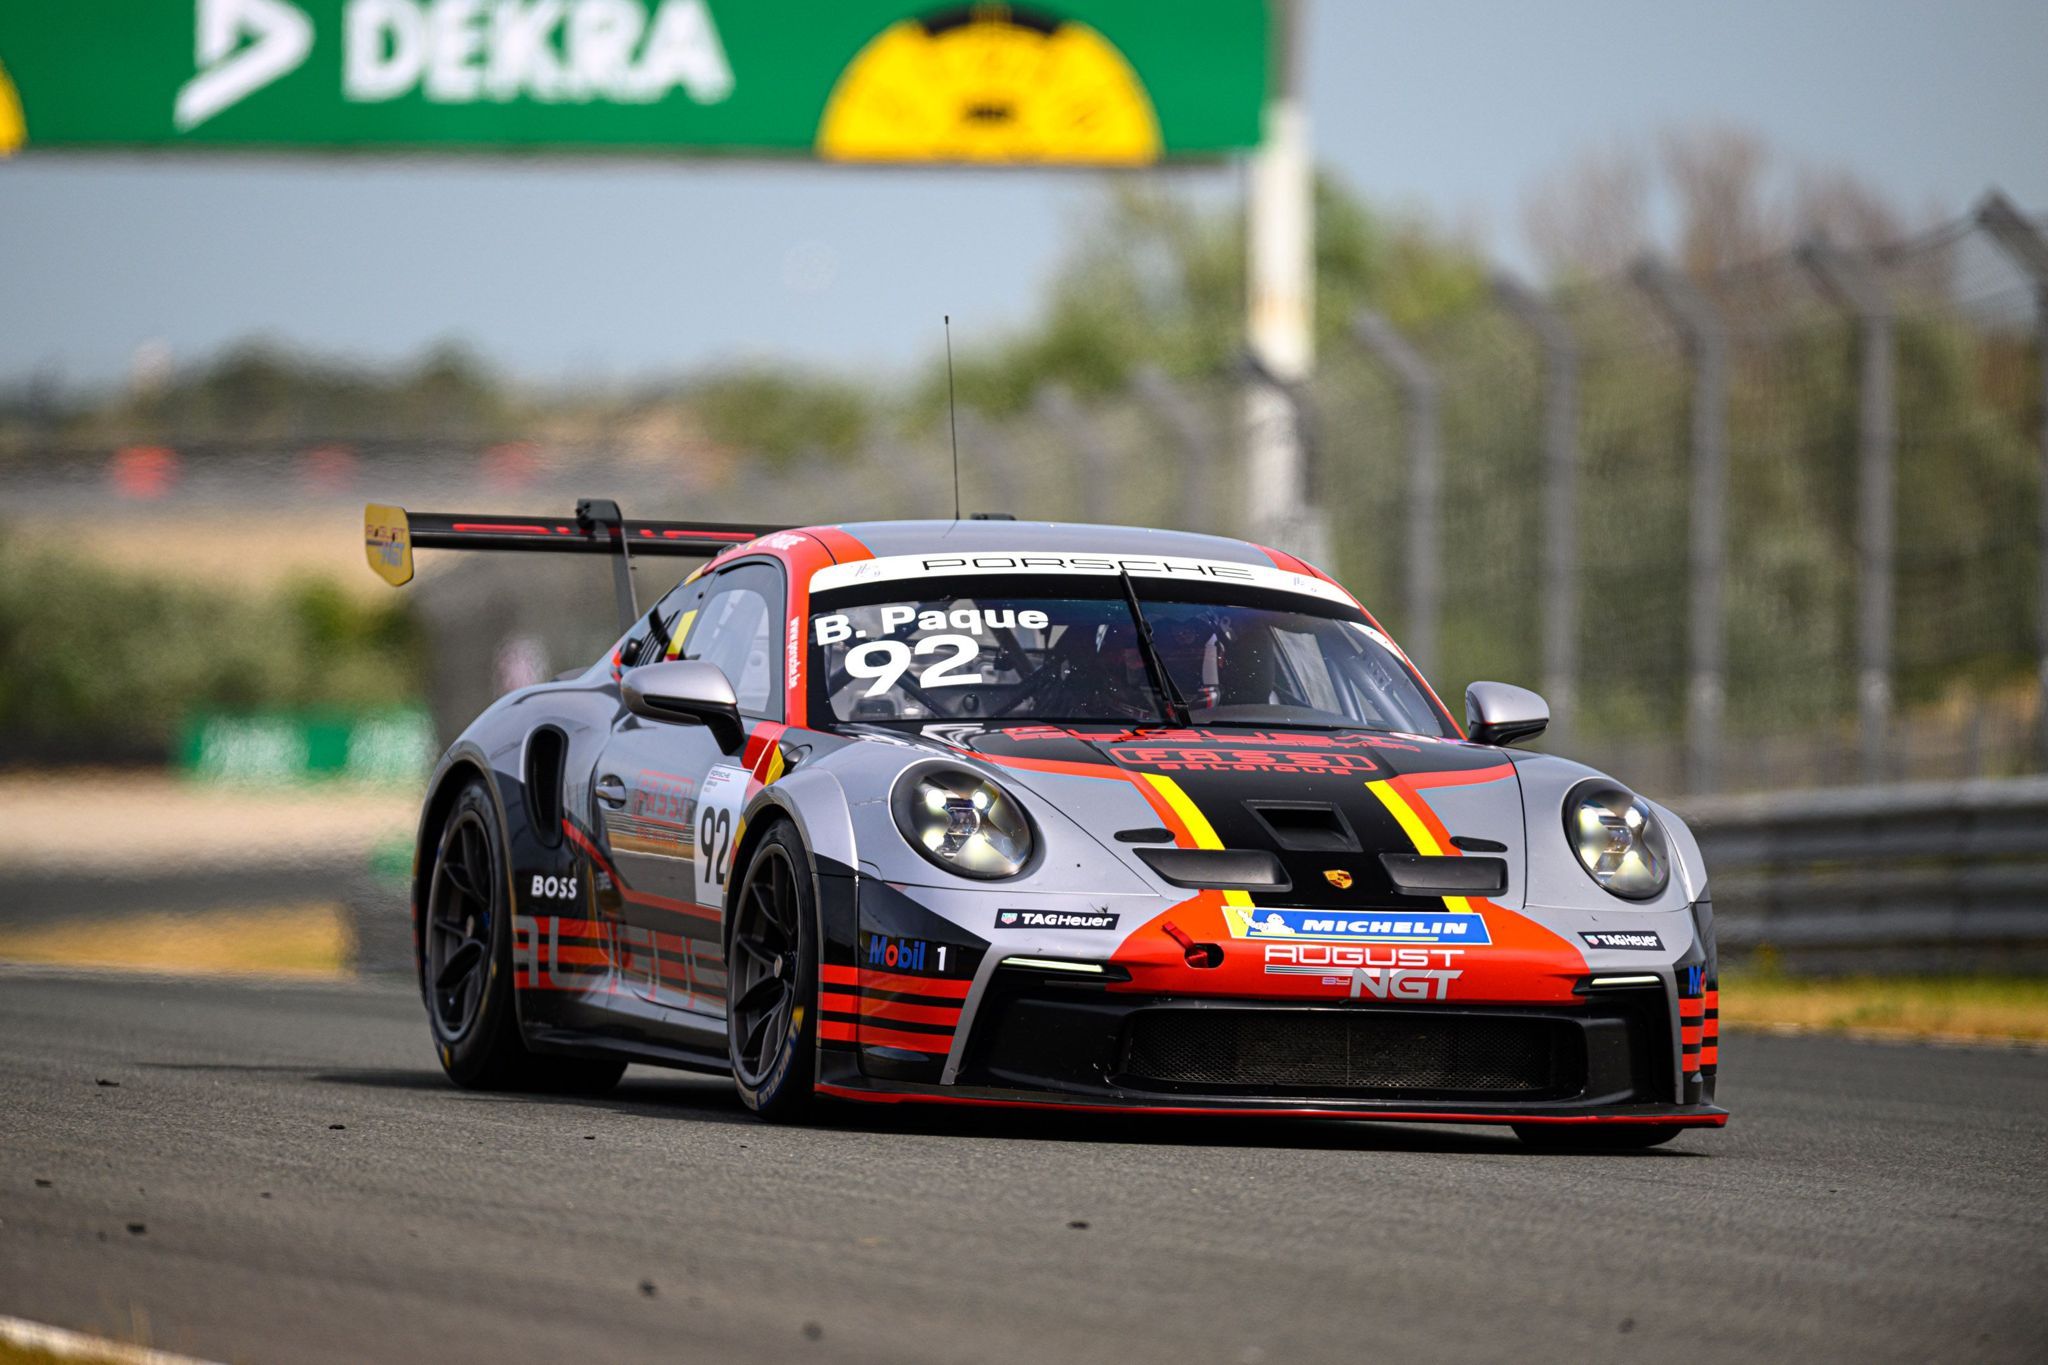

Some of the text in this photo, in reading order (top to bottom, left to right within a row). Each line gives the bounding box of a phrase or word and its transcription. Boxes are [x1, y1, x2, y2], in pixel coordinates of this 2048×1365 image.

[342, 0, 732, 102] DEKRA
[922, 557, 1255, 581] PORSCHE
[815, 606, 1049, 646] B. Paque
[844, 634, 983, 698] 92
[1134, 751, 1352, 768] FASSI
[701, 806, 731, 884] 92
[531, 874, 578, 899] BOSS
[1302, 919, 1468, 935] MICHELIN
[869, 934, 947, 971] Mobil 1
[1264, 944, 1465, 967] AUGUST
[1350, 968, 1464, 1000] NGT
